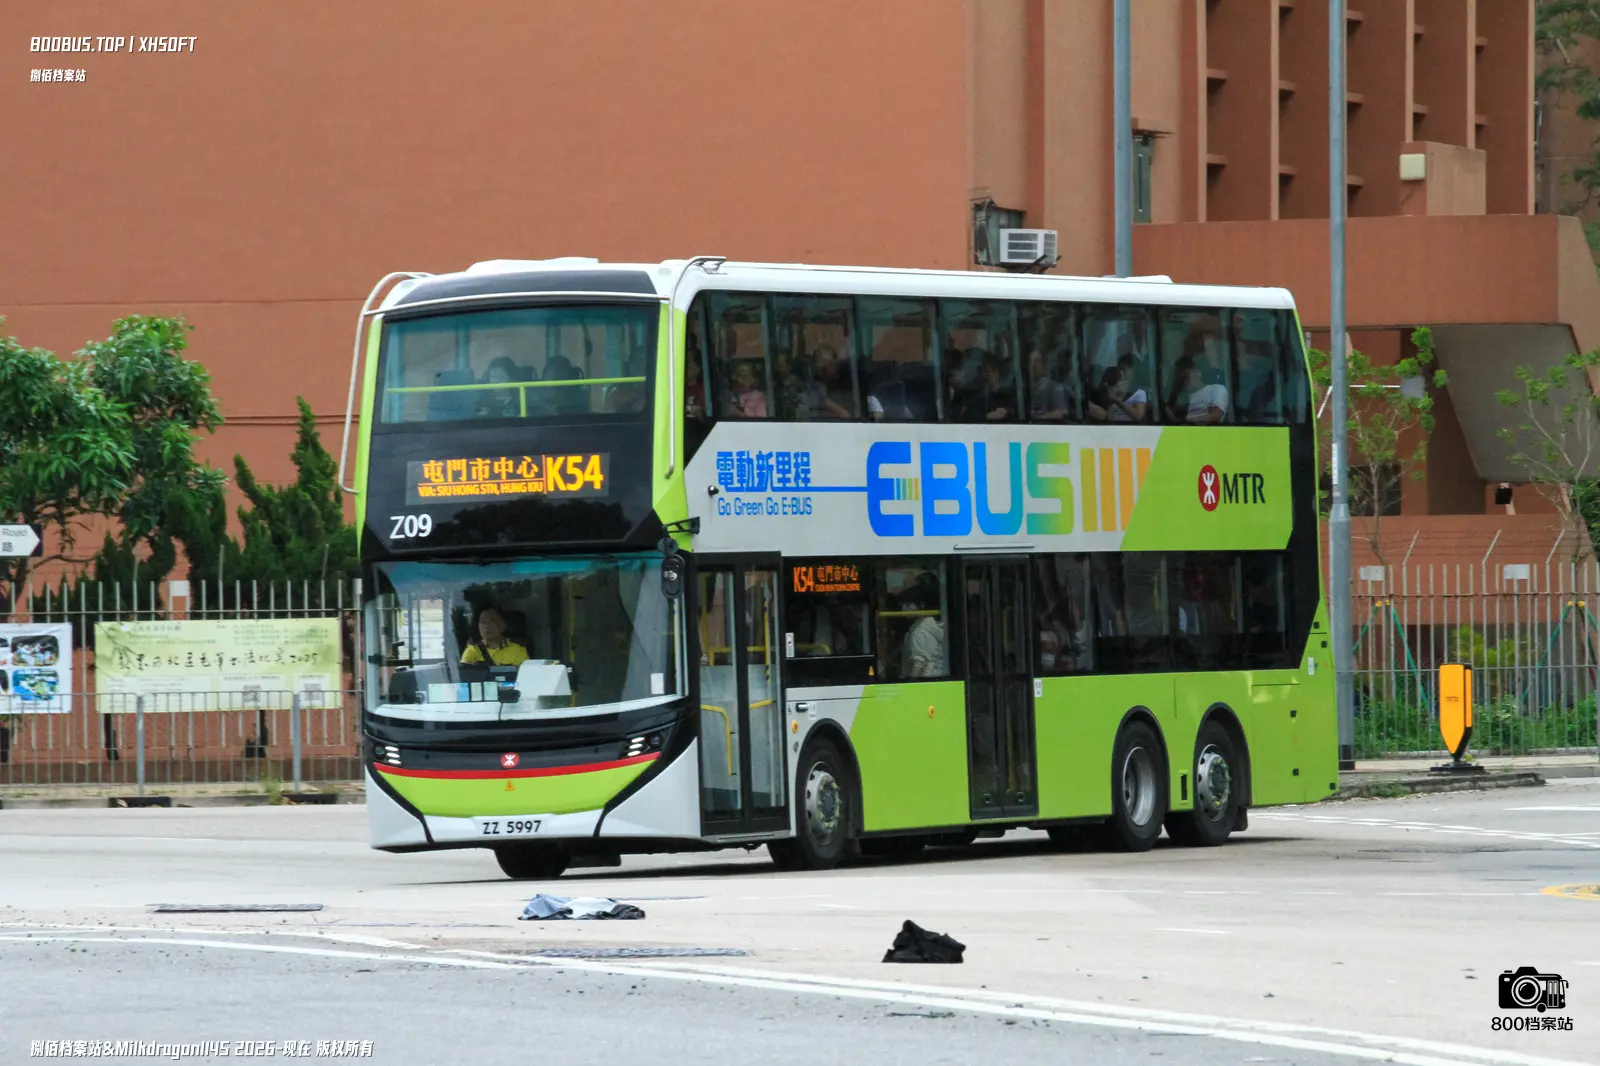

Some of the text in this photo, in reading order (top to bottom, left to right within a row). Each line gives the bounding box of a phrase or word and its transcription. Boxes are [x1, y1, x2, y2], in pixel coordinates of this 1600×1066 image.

[422, 455, 539, 483] 屯門市中心
[546, 454, 604, 492] K54
[716, 450, 811, 491] 電動新里程
[453, 483, 480, 496] HONG
[1222, 473, 1266, 505] MTR
[718, 496, 813, 515] Go Green Go E-BUS
[2, 527, 28, 537] Road
[389, 513, 433, 539] Z09
[793, 566, 815, 593] K54
[482, 819, 542, 835] ZZ 5997
